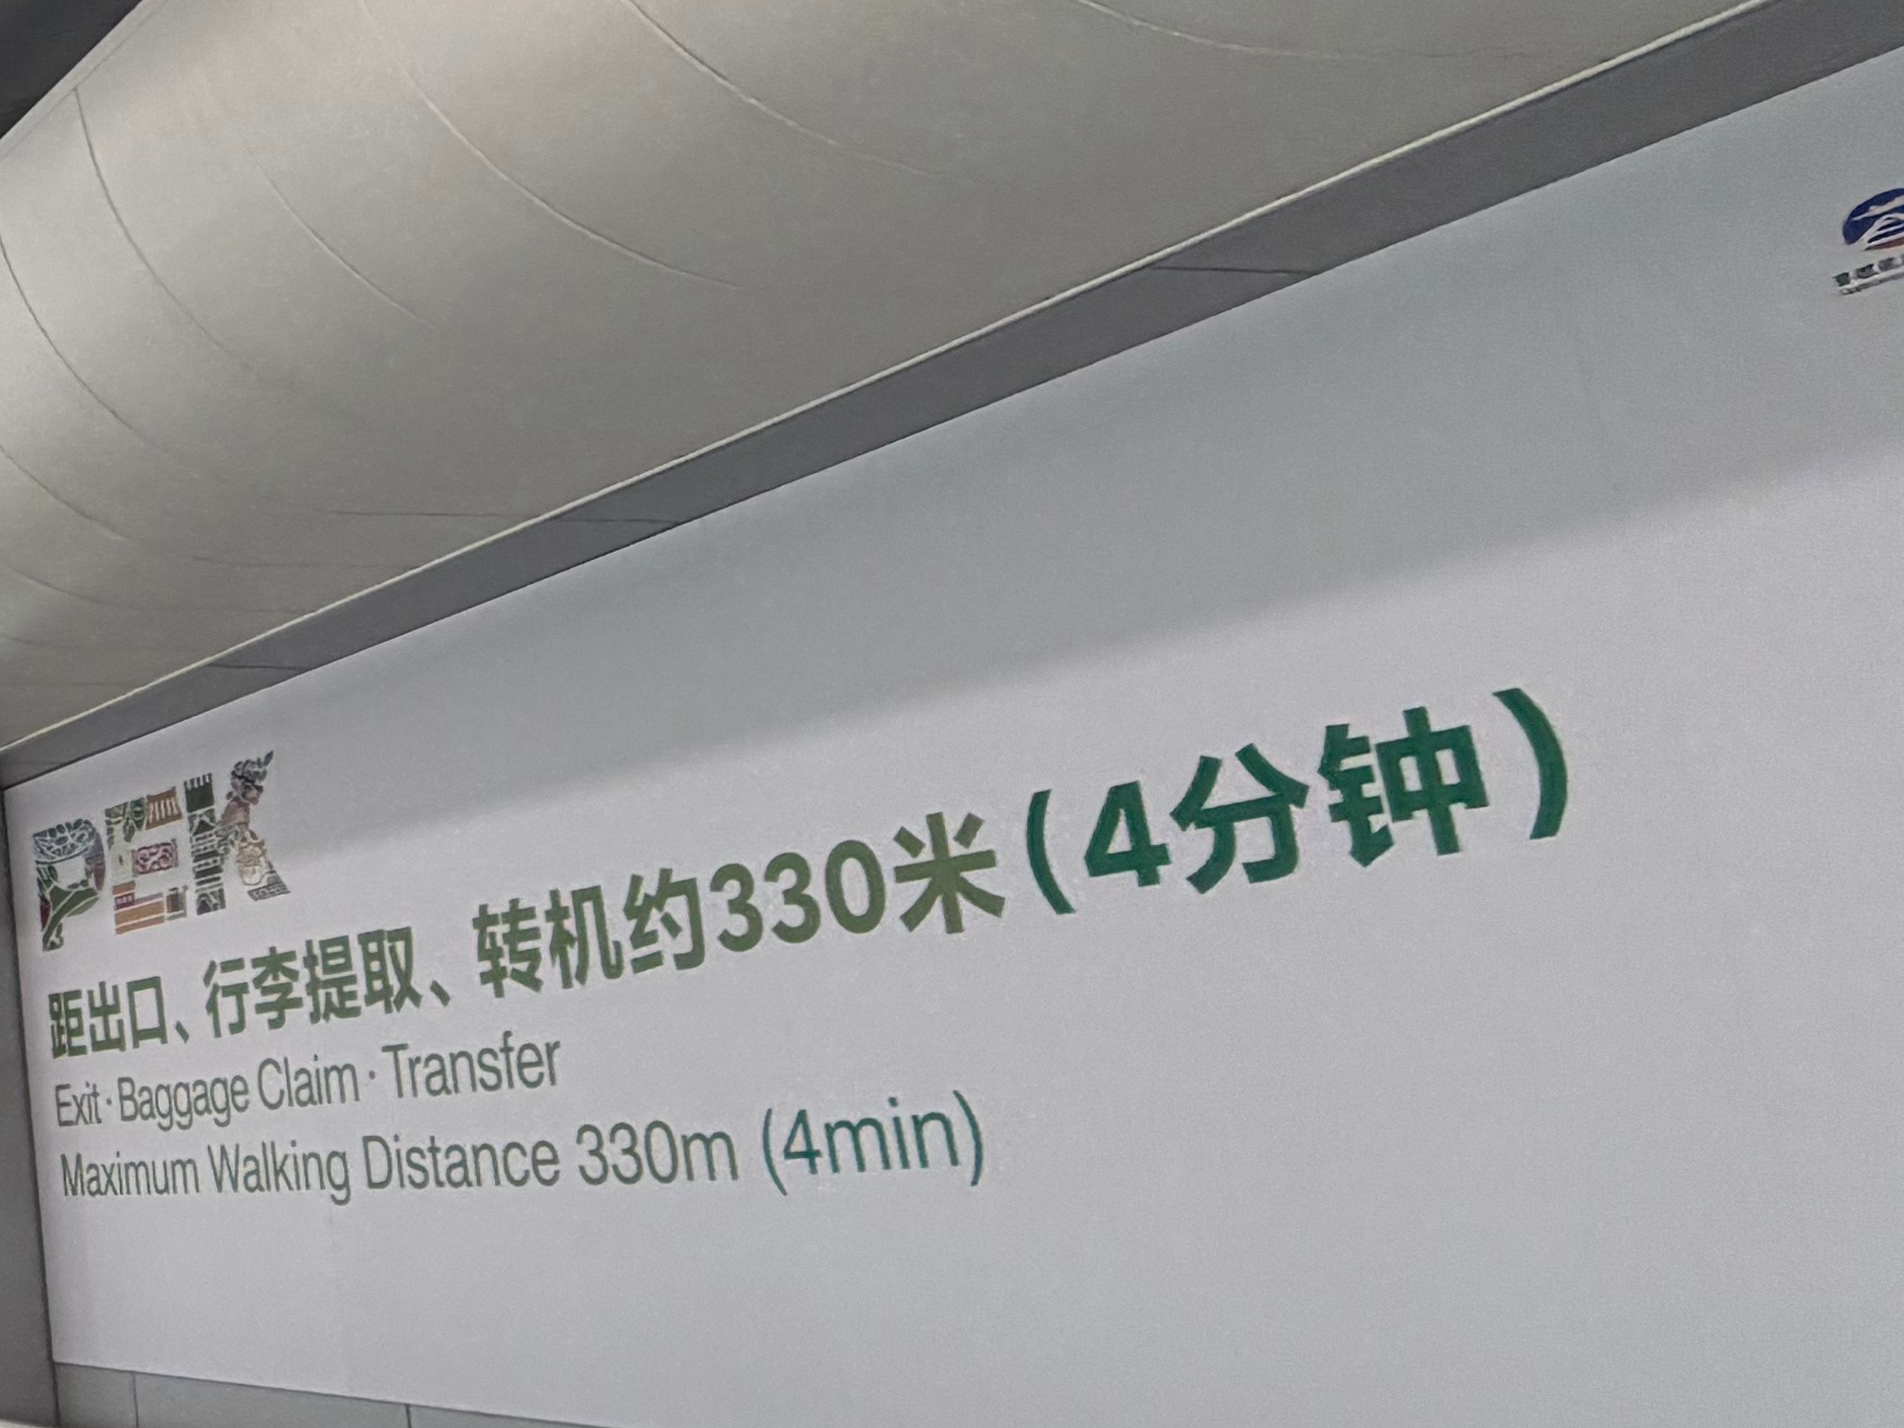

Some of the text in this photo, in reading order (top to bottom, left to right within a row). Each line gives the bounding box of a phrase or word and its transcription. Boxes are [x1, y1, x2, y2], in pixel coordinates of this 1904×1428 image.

[32, 750, 291, 952] PEK
[117, 1073, 250, 1132] Baggage
[257, 1054, 360, 1111] Claim
[381, 1030, 561, 1099] Transfer
[60, 1090, 984, 1206] Maximum Walking Distance 330m (4min)
